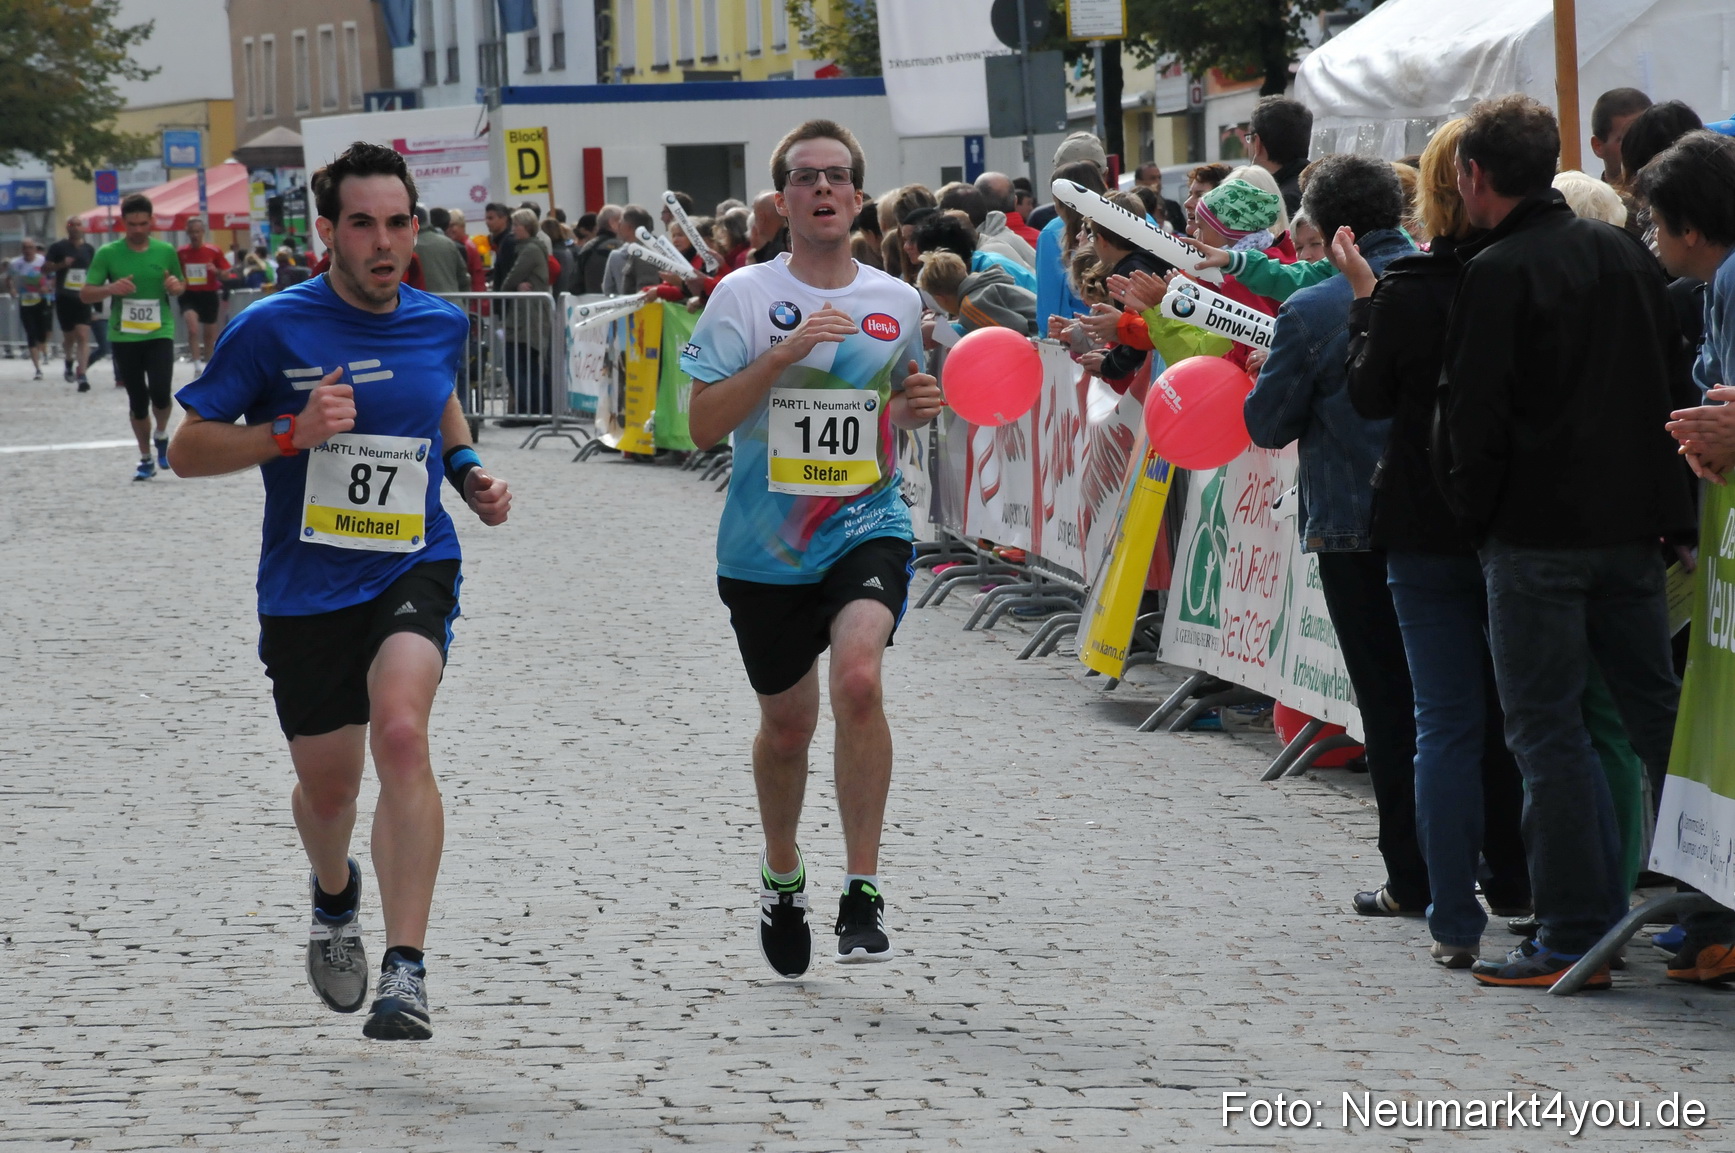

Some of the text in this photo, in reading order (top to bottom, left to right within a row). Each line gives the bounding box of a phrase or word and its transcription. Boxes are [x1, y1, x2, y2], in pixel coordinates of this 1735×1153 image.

[509, 131, 543, 143] Block
[517, 148, 541, 180] D
[130, 308, 153, 321] 502
[867, 319, 896, 335] Hervis
[772, 398, 860, 411] PARTL Neumarkt
[794, 416, 860, 456] 140
[314, 443, 413, 460] PARTL Neumarkt
[803, 464, 848, 482] Stefan
[348, 463, 398, 506] 87
[335, 514, 400, 536] Michael
